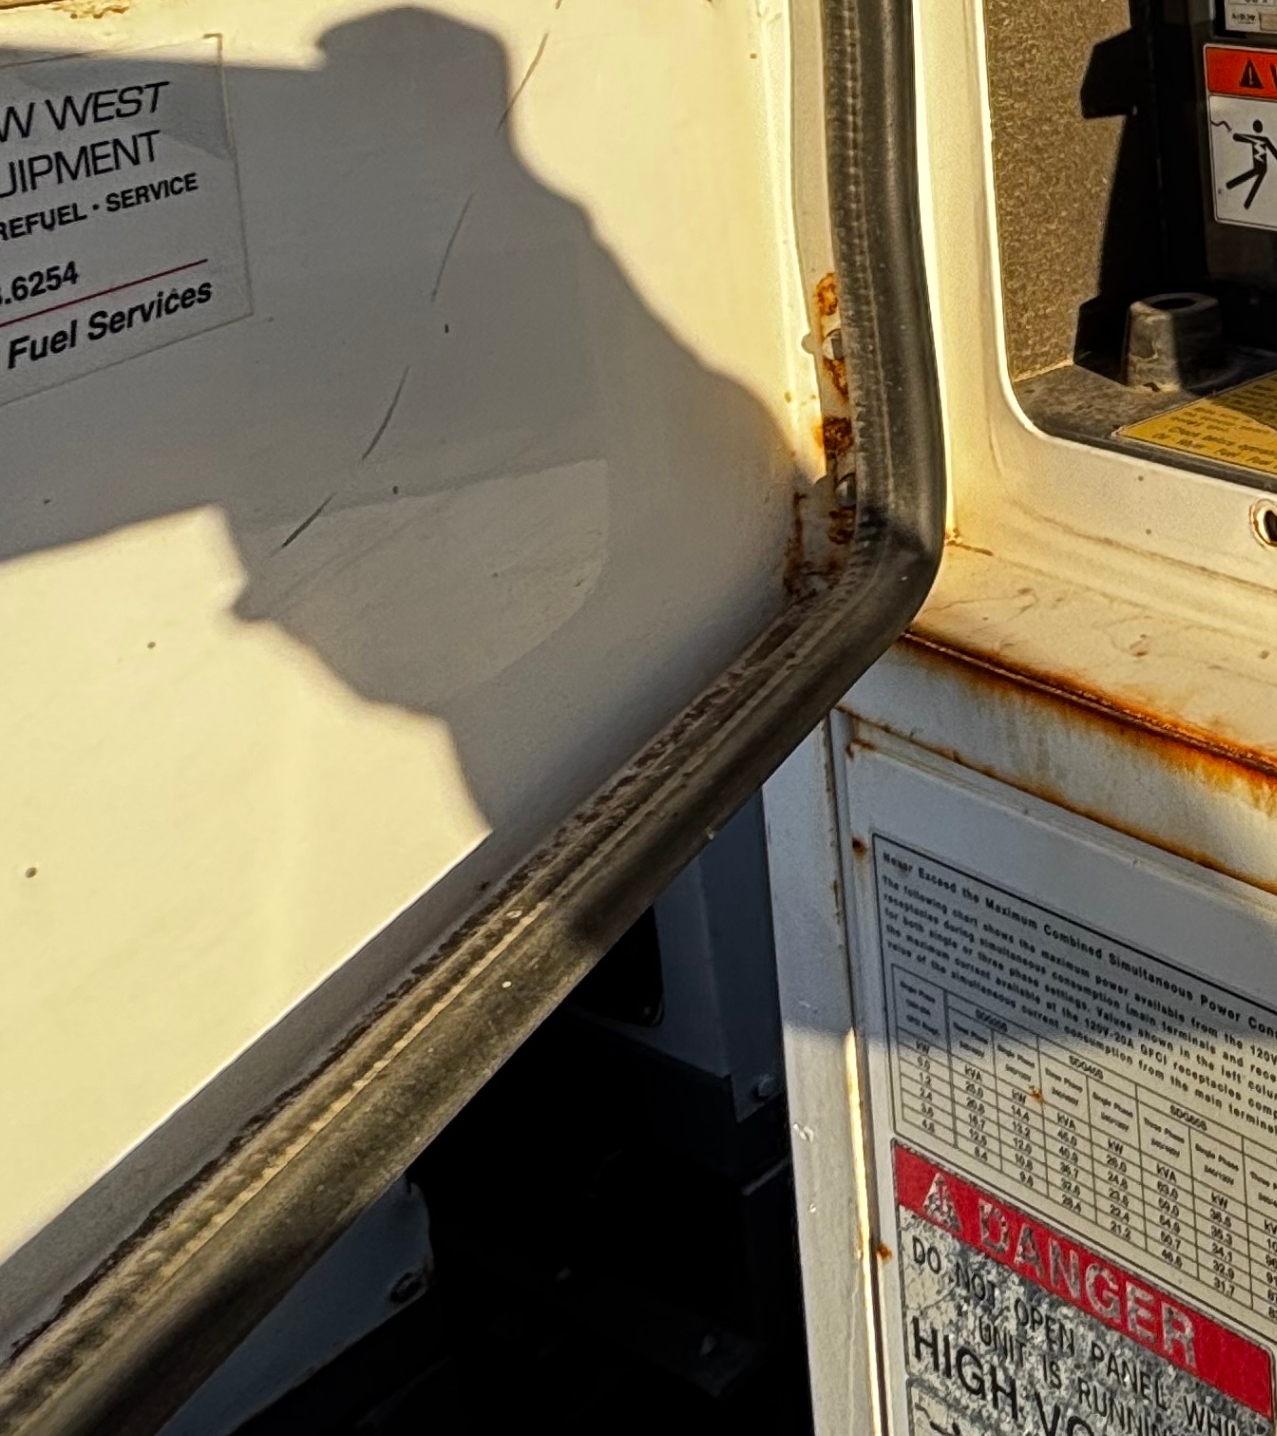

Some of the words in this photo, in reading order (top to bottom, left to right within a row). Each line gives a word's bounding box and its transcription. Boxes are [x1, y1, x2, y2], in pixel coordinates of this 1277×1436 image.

[45, 81, 170, 131] WEST
[106, 172, 198, 213] SERVICE
[8, 320, 77, 370] Fuel
[88, 282, 213, 341] Services
[919, 867, 957, 894] Exceed
[962, 887, 980, 904] the
[985, 897, 1038, 931] Maximum
[1044, 923, 1103, 960] Combined
[1109, 952, 1194, 1001] Simultaneous
[1200, 994, 1242, 1023] Power
[912, 1235, 942, 1275] DO
[978, 1198, 1198, 1368] DANGER
[913, 1316, 1018, 1422] HIGH
